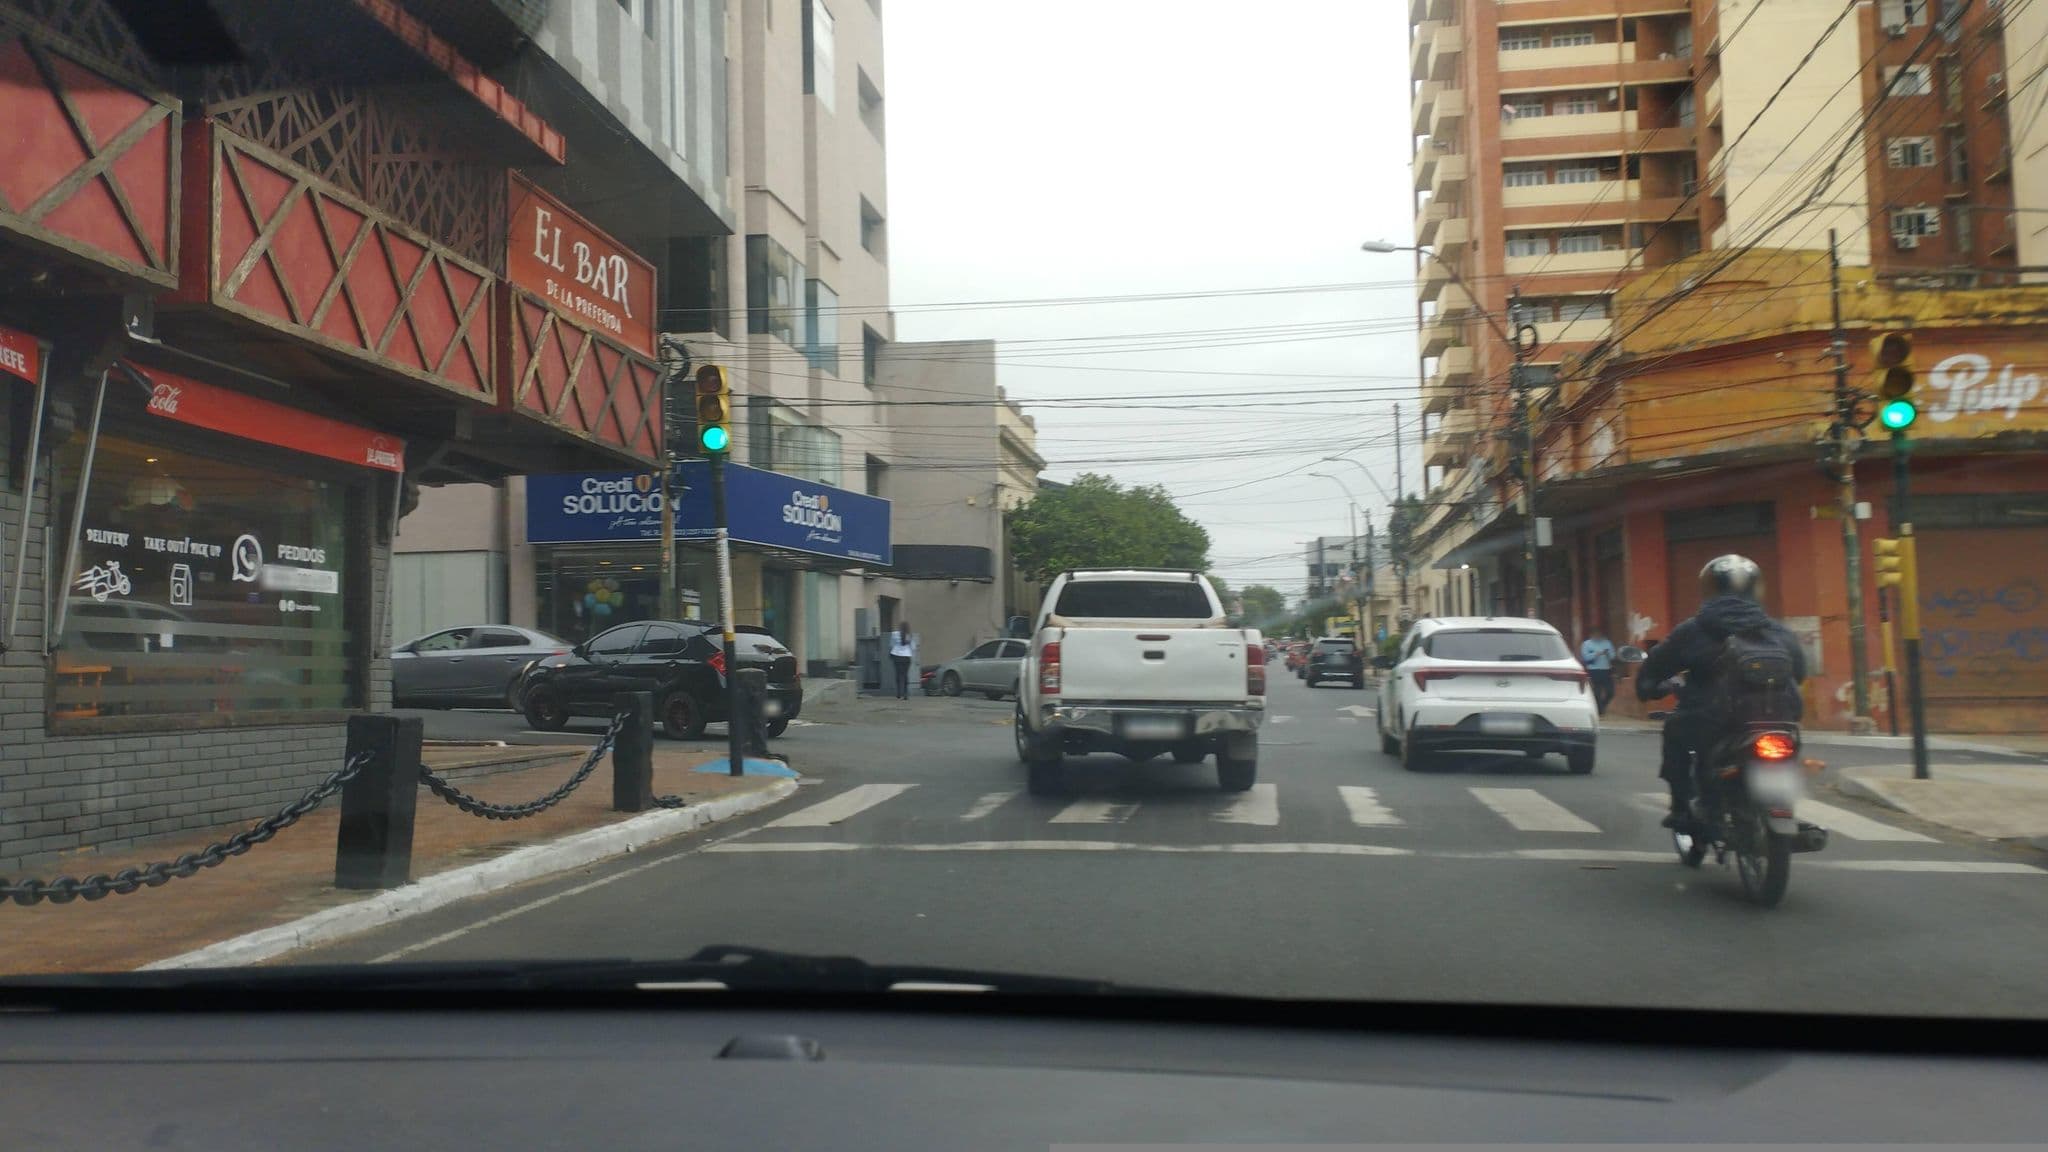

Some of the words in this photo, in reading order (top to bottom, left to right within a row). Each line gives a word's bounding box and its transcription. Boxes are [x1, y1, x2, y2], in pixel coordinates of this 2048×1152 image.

[534, 206, 565, 272] EL
[573, 241, 632, 318] BAR
[545, 279, 559, 299] DE
[561, 288, 573, 308] LA
[1928, 353, 2041, 422] Pulp
[581, 477, 633, 494] Credi
[86, 528, 129, 547] DELIVERY
[143, 536, 166, 552] TAKE
[277, 544, 326, 563] PEDIDOS
